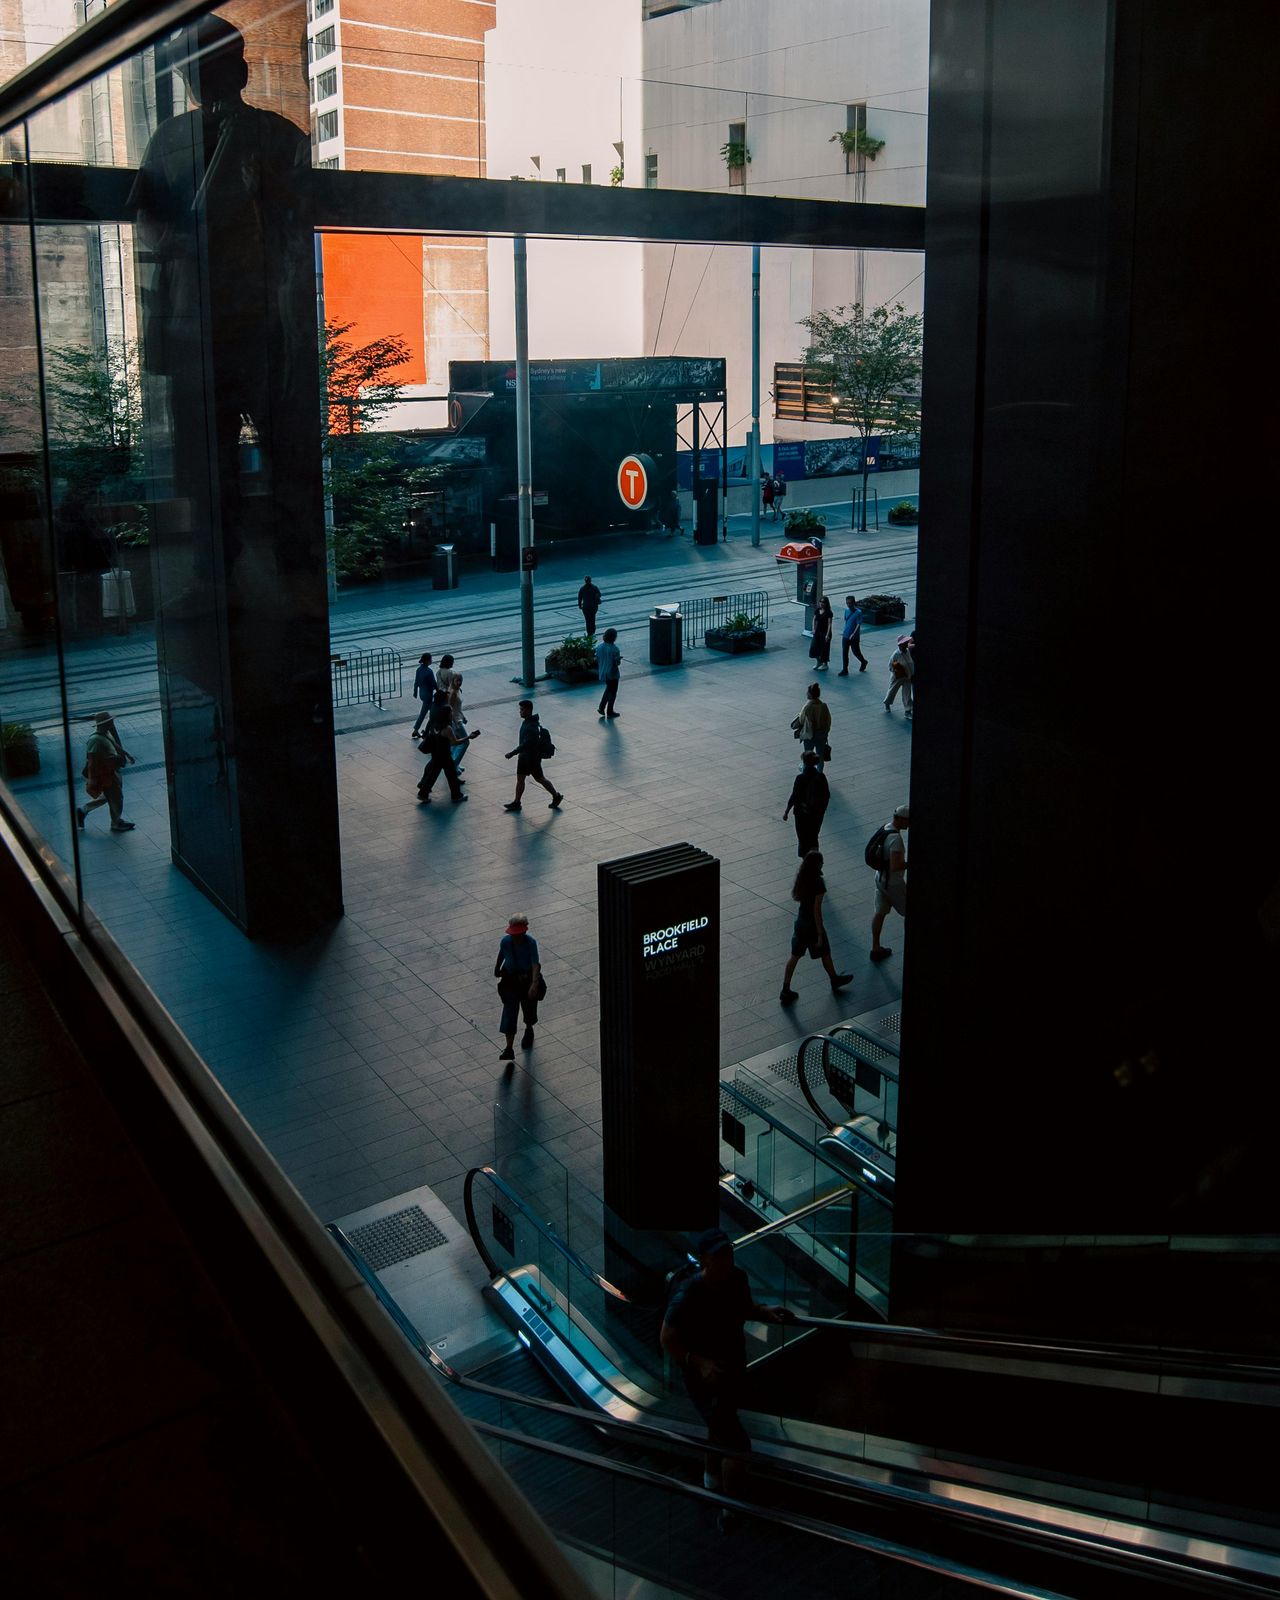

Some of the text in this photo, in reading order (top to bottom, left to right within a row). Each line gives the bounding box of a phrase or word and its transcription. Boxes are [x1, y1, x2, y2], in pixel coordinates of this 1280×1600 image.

[625, 469, 639, 499] T
[642, 916, 709, 945] BROOKFIELD
[643, 937, 679, 958] PLACE
[644, 944, 705, 971] WYNYARD
